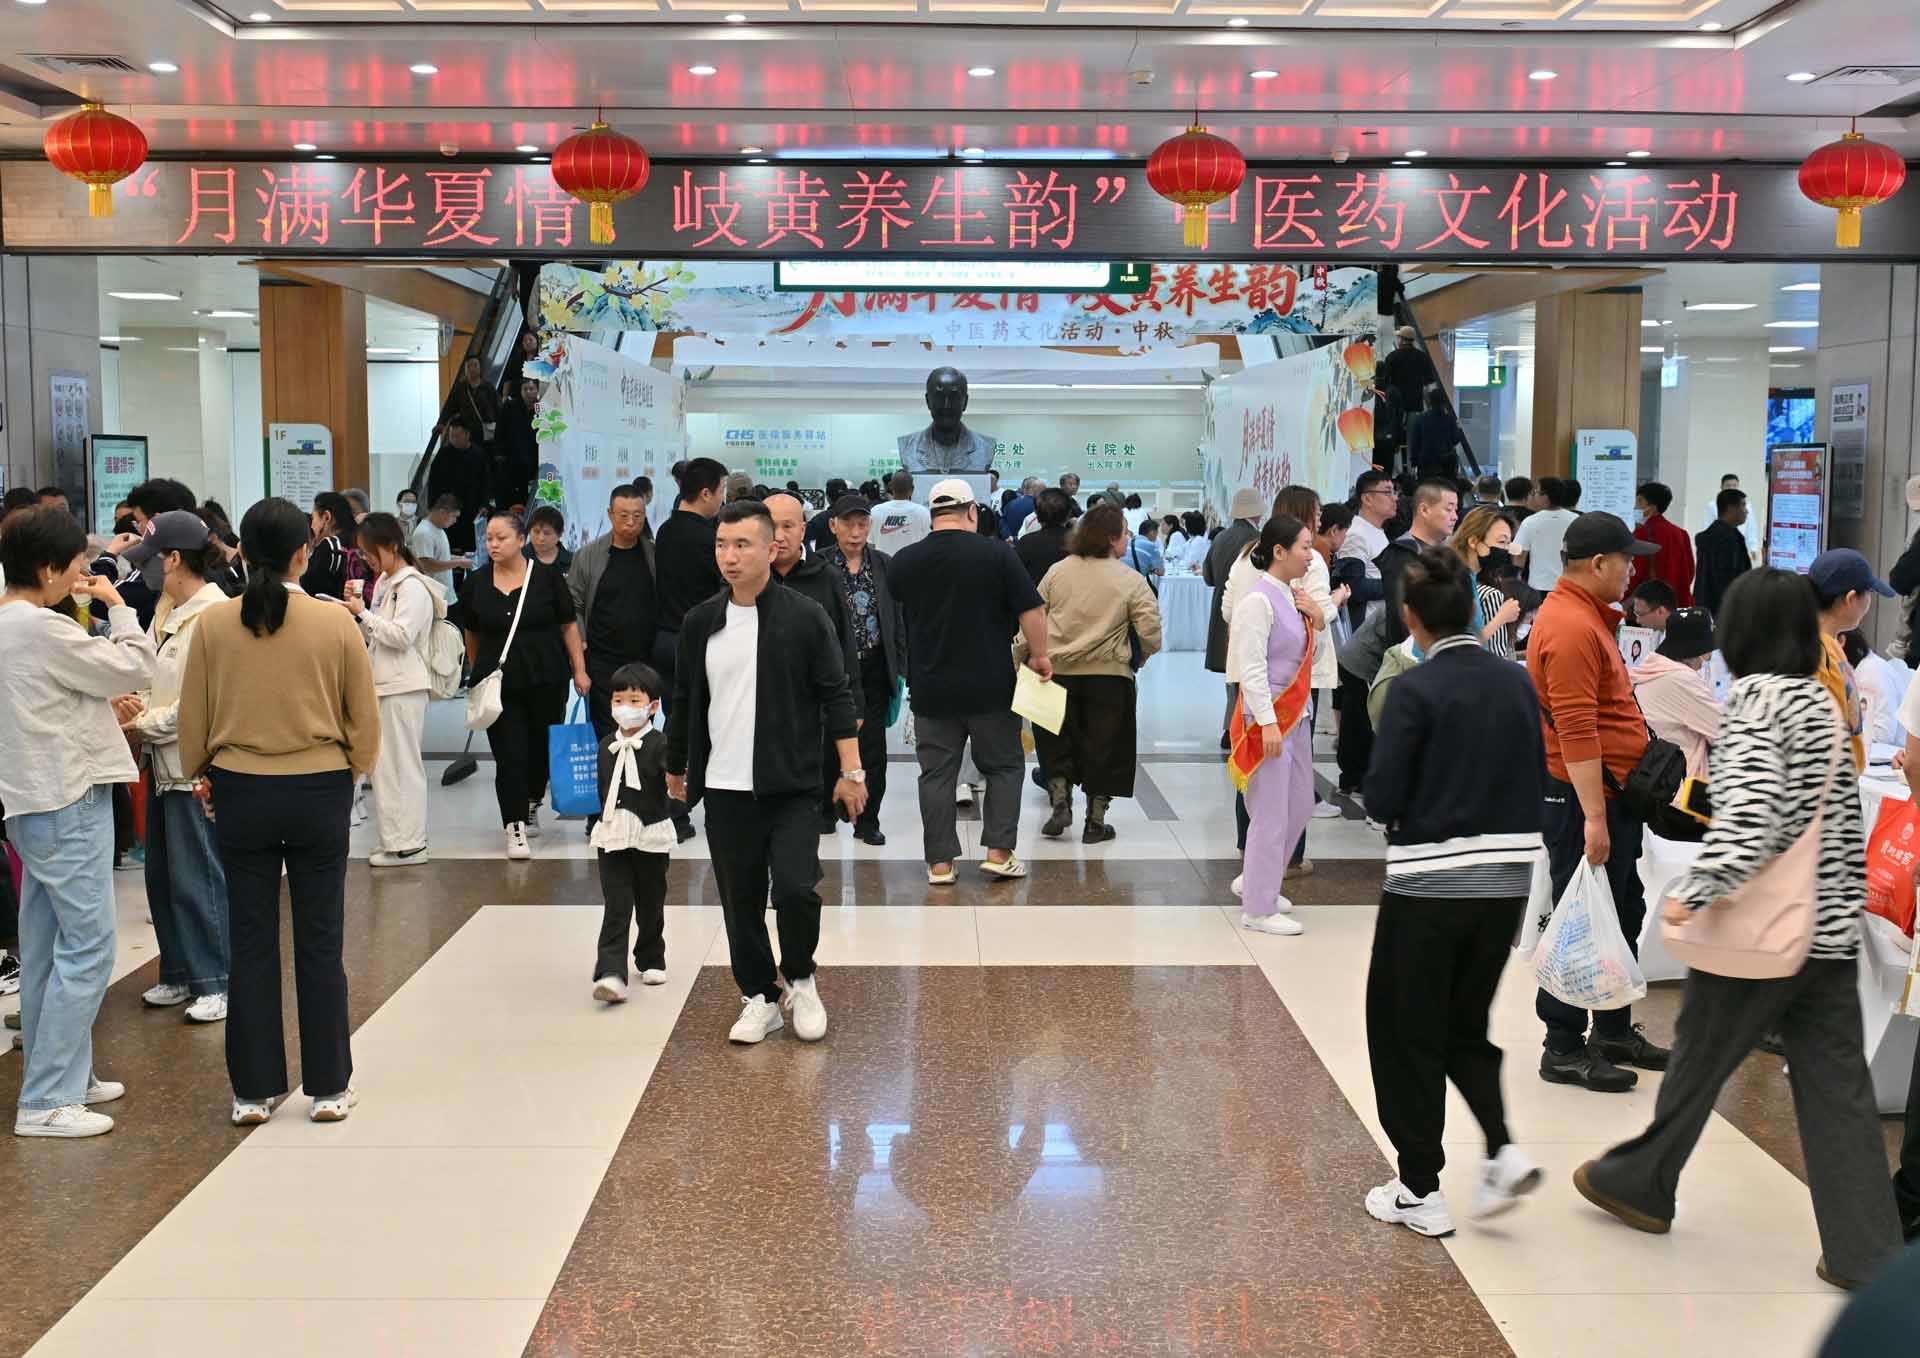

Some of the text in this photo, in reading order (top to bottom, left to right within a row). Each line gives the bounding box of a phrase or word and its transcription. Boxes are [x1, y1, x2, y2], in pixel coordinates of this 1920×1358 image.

[274, 430, 287, 441] 1F
[1583, 436, 1596, 447] 1F
[1086, 443, 1136, 456] 住院处
[885, 515, 907, 526] NIKE
